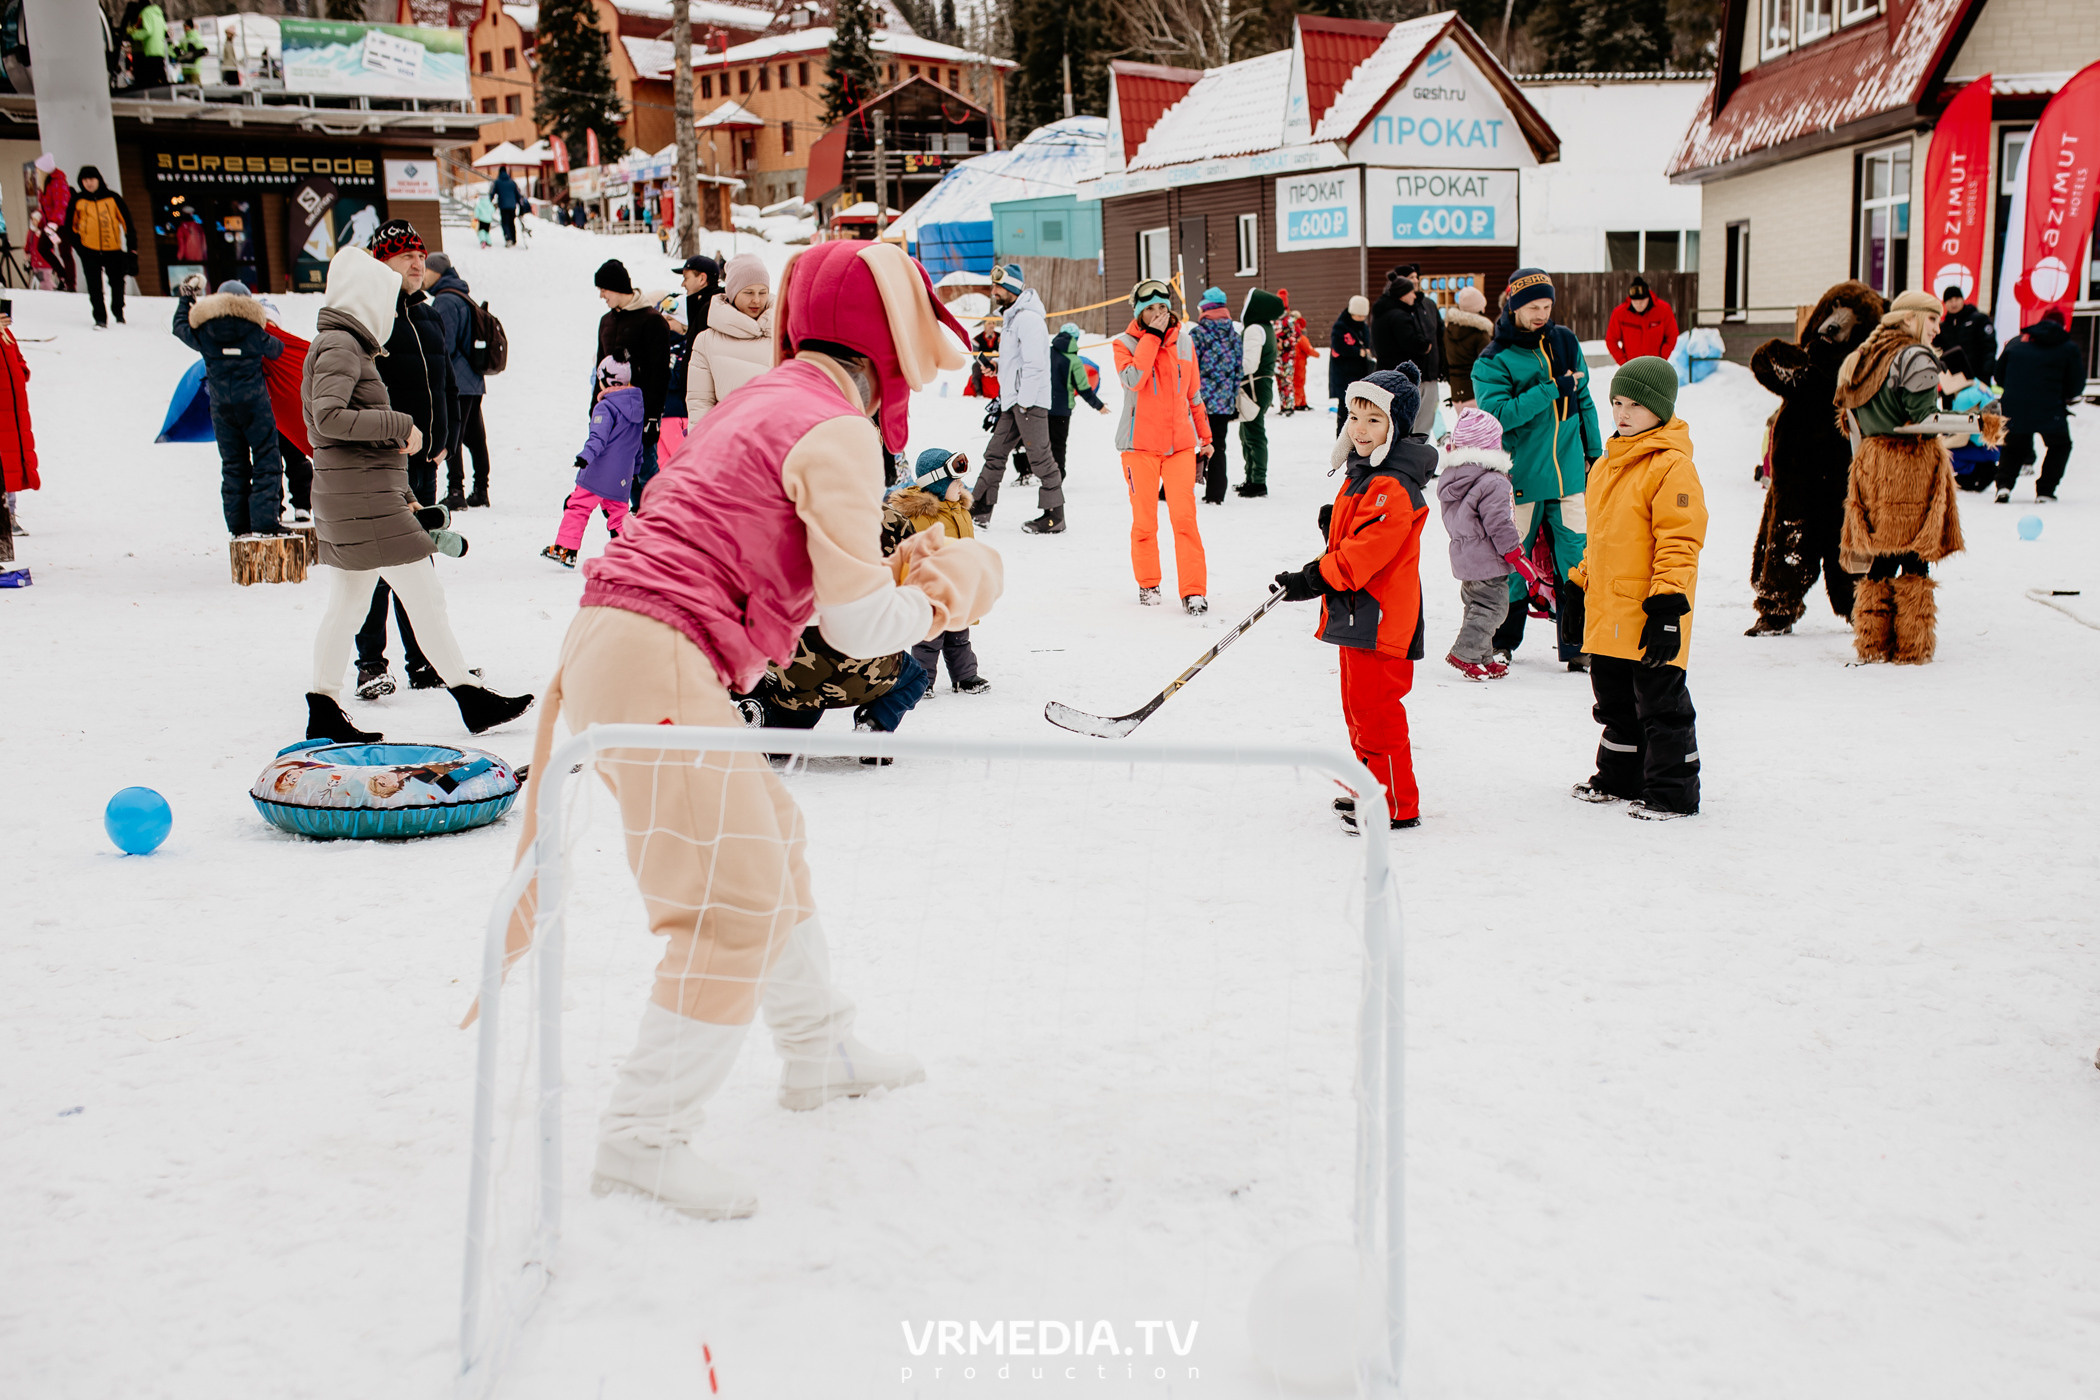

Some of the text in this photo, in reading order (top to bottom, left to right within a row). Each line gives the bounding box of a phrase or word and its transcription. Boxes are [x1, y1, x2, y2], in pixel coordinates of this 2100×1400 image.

[1373, 116, 1503, 148] ПРОКАТ
[1168, 166, 1202, 182] СЕРВИС
[1250, 154, 1288, 171] ПРОКАТ
[1289, 180, 1345, 204] ПРОКАТ
[1396, 176, 1489, 198] ПРОКАТ
[2069, 167, 2088, 218] HOTELS
[1966, 180, 1978, 226] HOTELS
